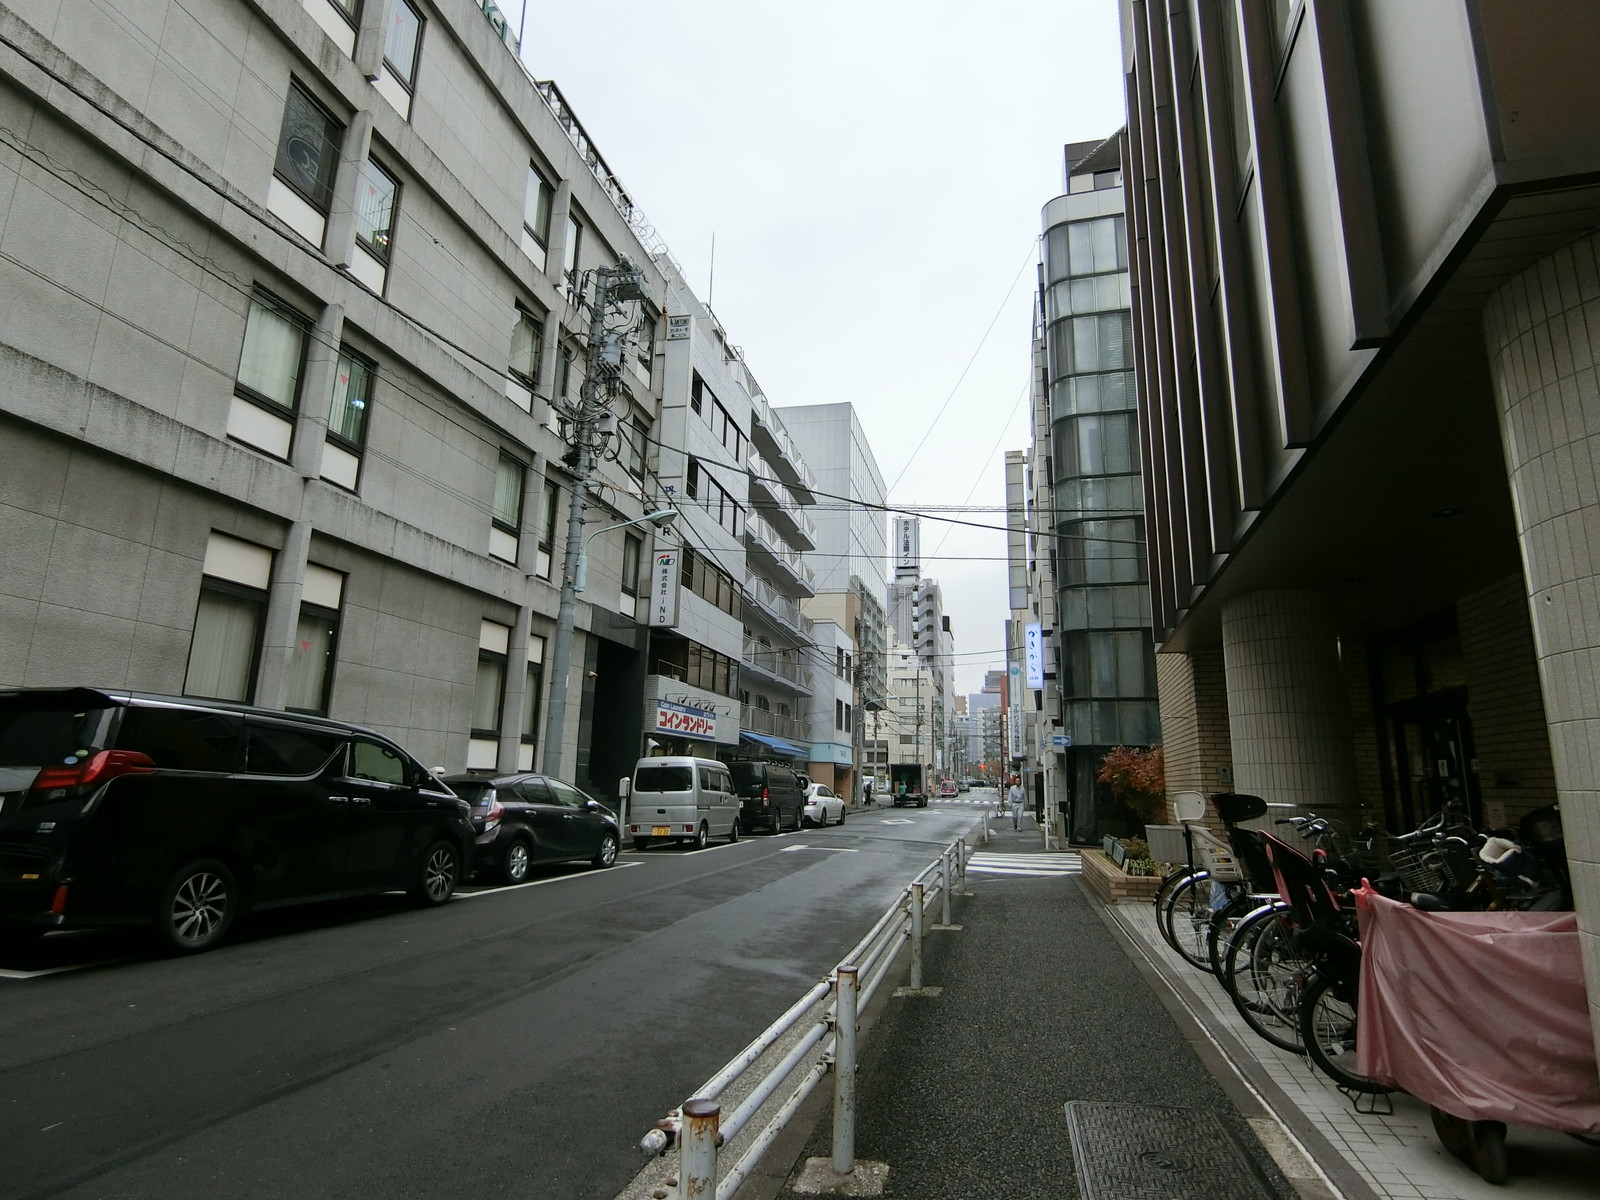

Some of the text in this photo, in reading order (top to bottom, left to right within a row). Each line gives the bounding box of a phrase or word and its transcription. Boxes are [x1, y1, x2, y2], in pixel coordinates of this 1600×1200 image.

[659, 711, 714, 735] コインランドリー
